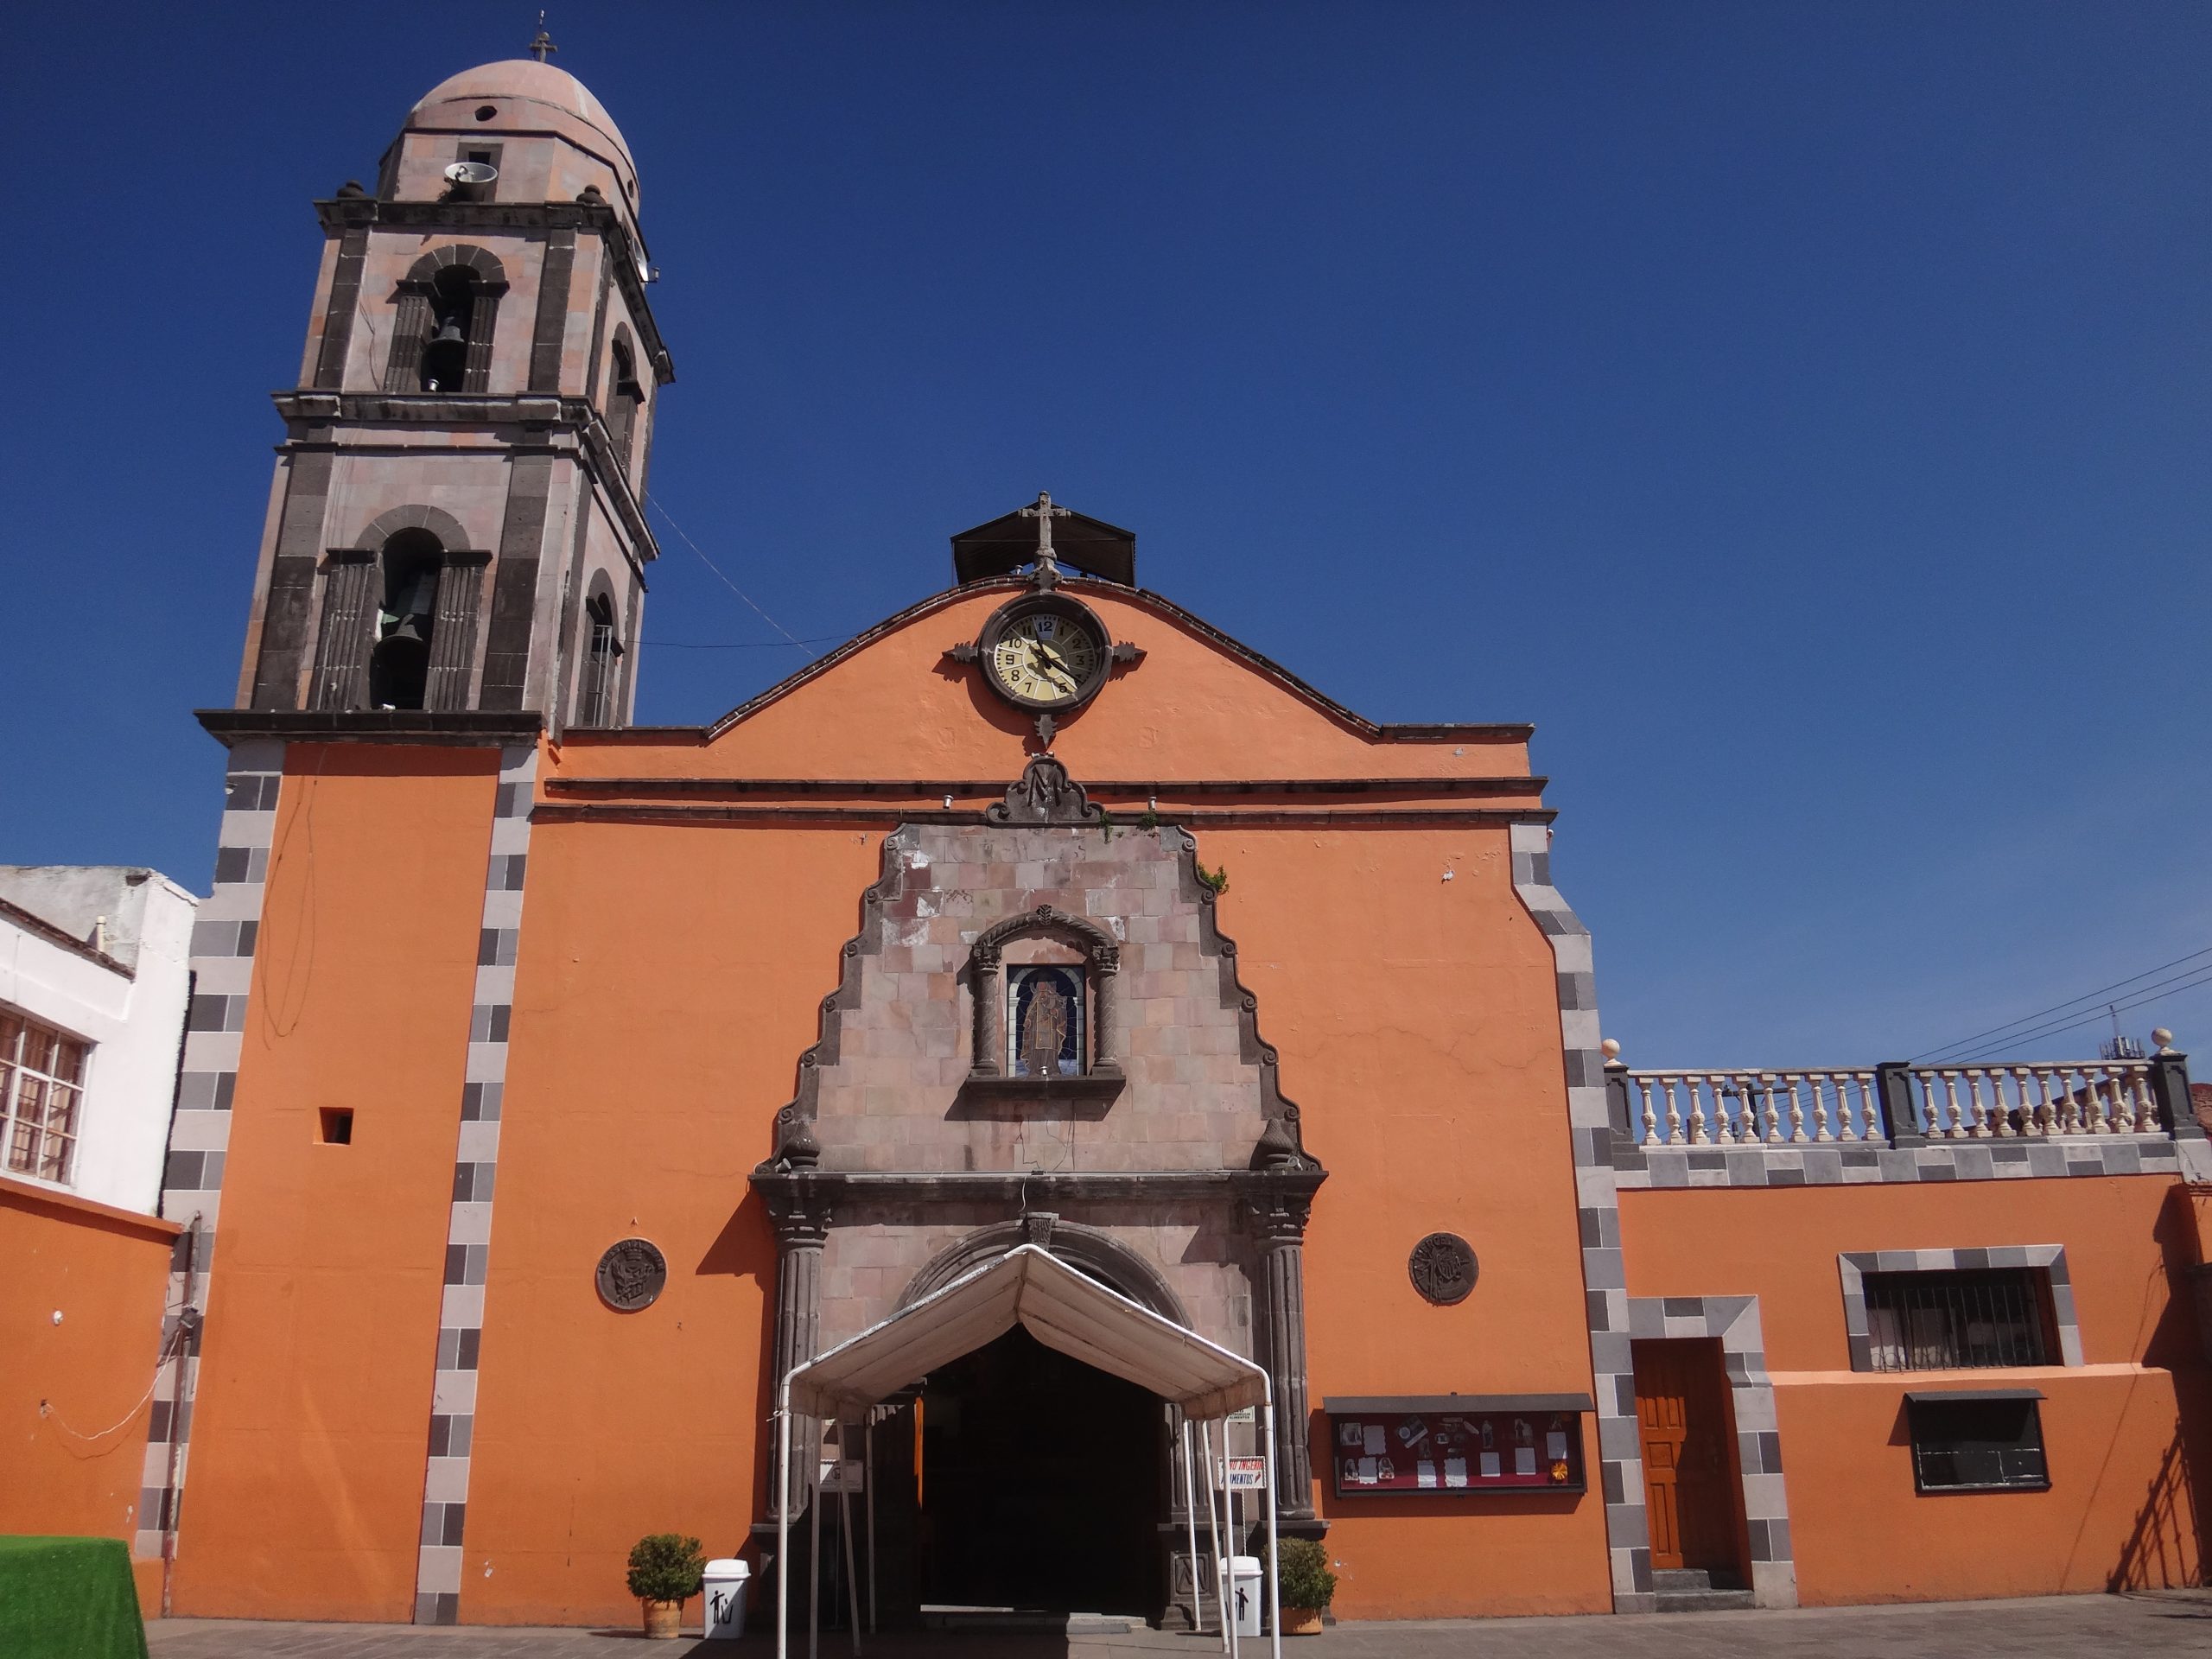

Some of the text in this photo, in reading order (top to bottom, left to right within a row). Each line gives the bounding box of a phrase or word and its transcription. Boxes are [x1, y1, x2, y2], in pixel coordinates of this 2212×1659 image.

[1024, 626, 1032, 636] 11
[1038, 620, 1052, 632] 12
[1060, 626, 1065, 636] 1
[1008, 639, 1021, 649] 10
[1073, 639, 1081, 649] 2
[1006, 655, 1014, 665] 9
[1077, 655, 1084, 665] 3
[1012, 670, 1020, 682] 8
[1025, 682, 1032, 693] 7
